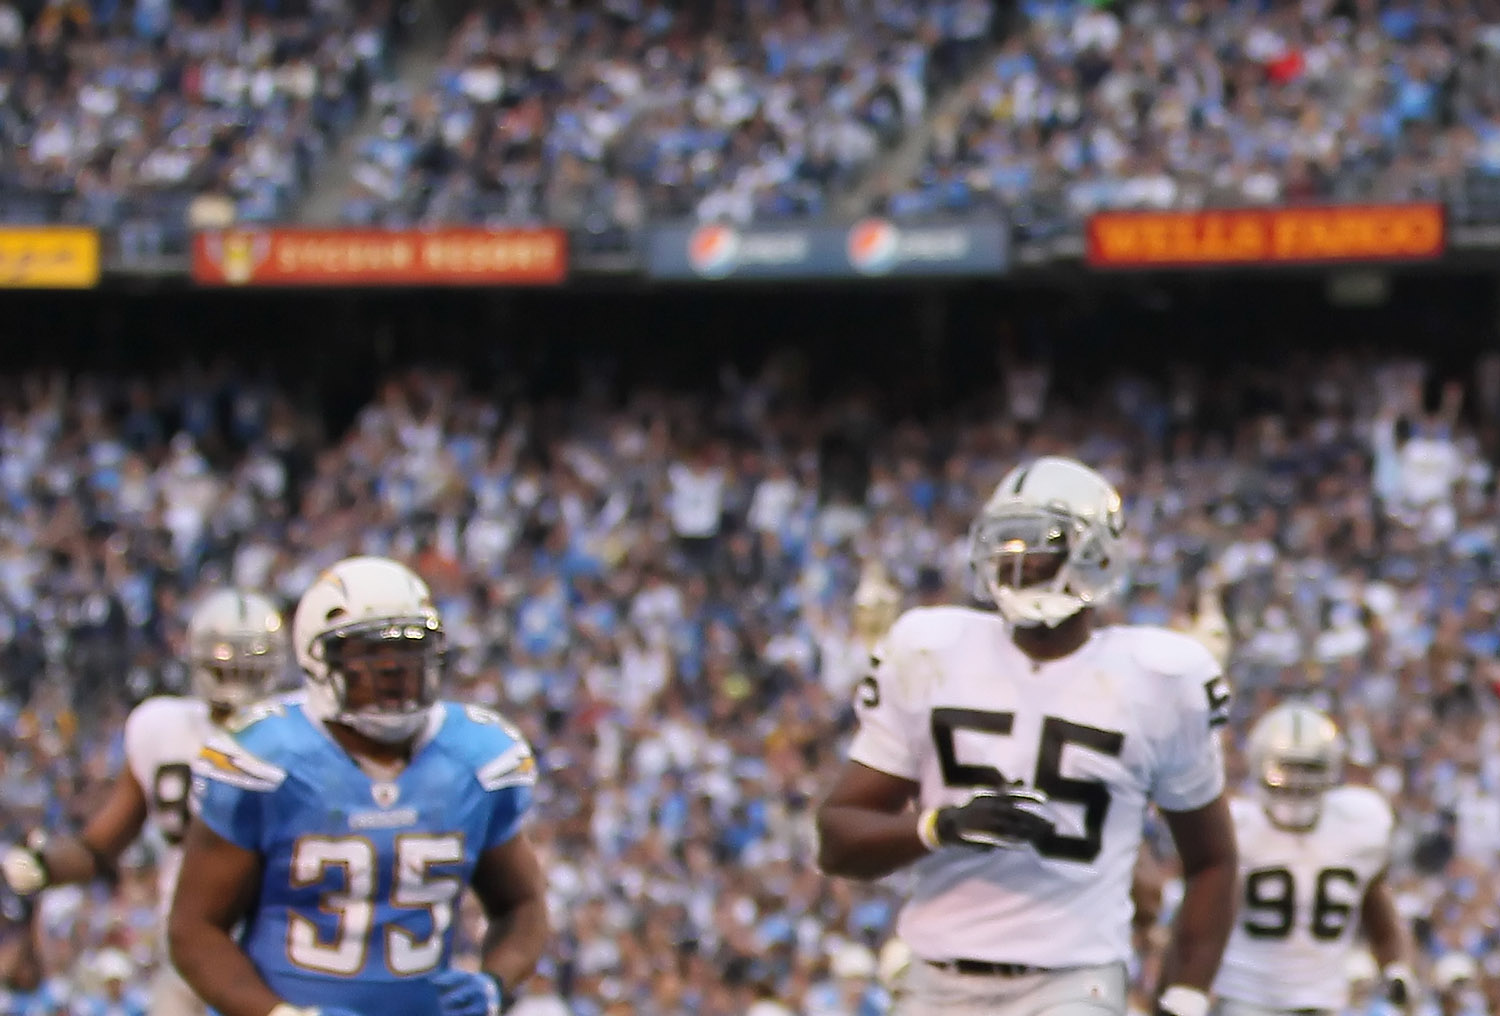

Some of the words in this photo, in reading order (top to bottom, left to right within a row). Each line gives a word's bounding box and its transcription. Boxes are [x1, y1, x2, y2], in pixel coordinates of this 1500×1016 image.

[1103, 213, 1266, 263] WELLS
[1273, 205, 1441, 260] FARGO
[931, 706, 1125, 863] 55
[287, 833, 465, 978] 35
[1243, 867, 1358, 939] 96
